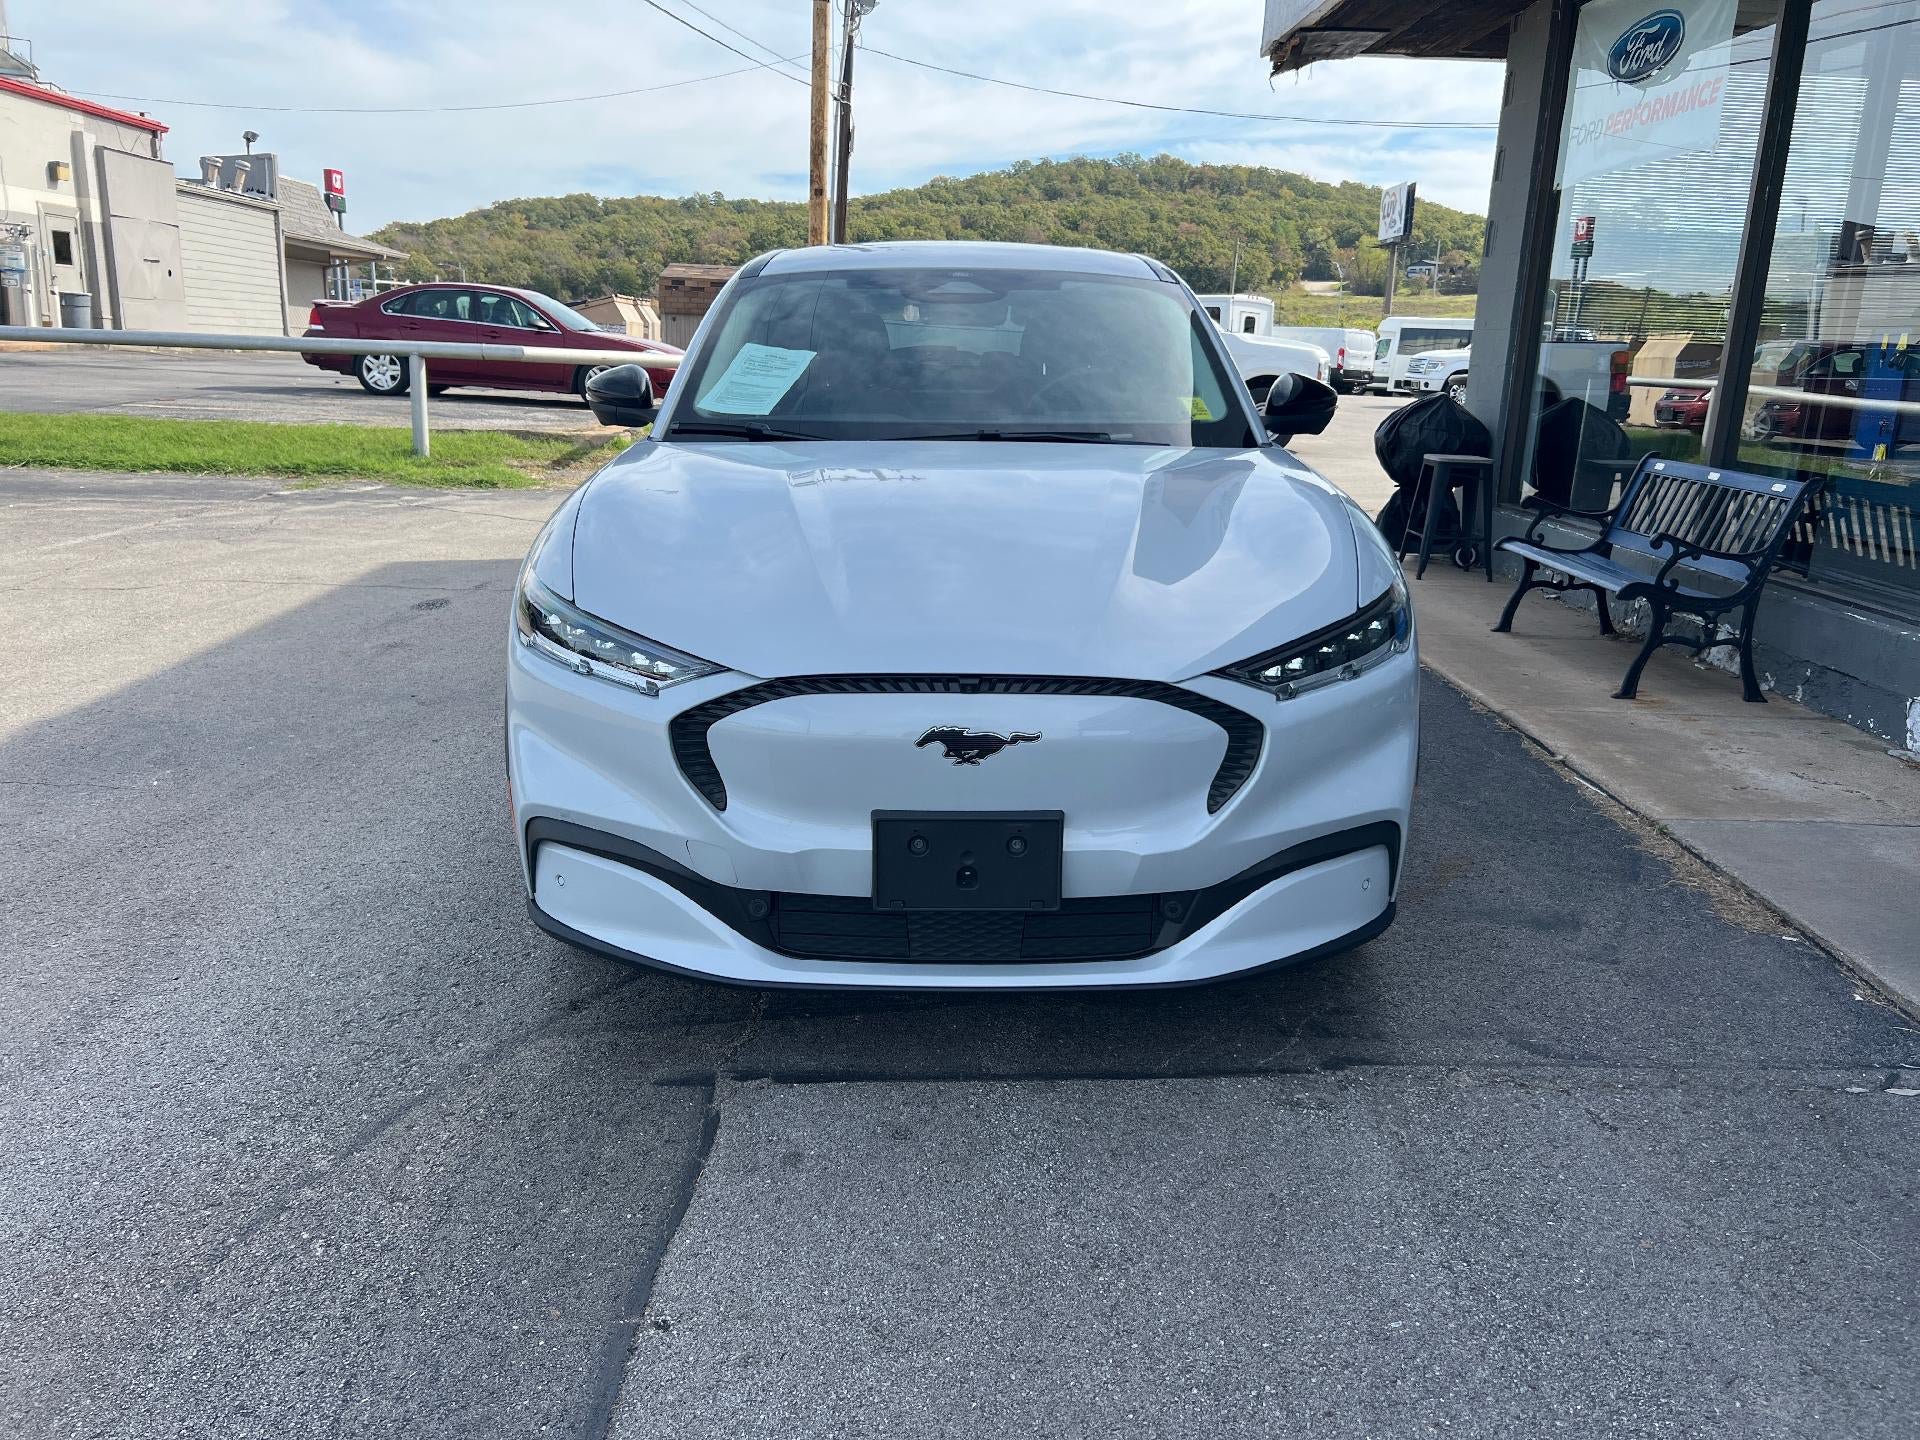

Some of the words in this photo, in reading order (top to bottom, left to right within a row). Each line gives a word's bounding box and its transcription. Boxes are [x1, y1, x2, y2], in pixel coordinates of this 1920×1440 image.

[1619, 23, 1670, 75] Ford
[1570, 118, 1604, 146] FORD
[1604, 78, 1722, 136] PERFORMANCE
